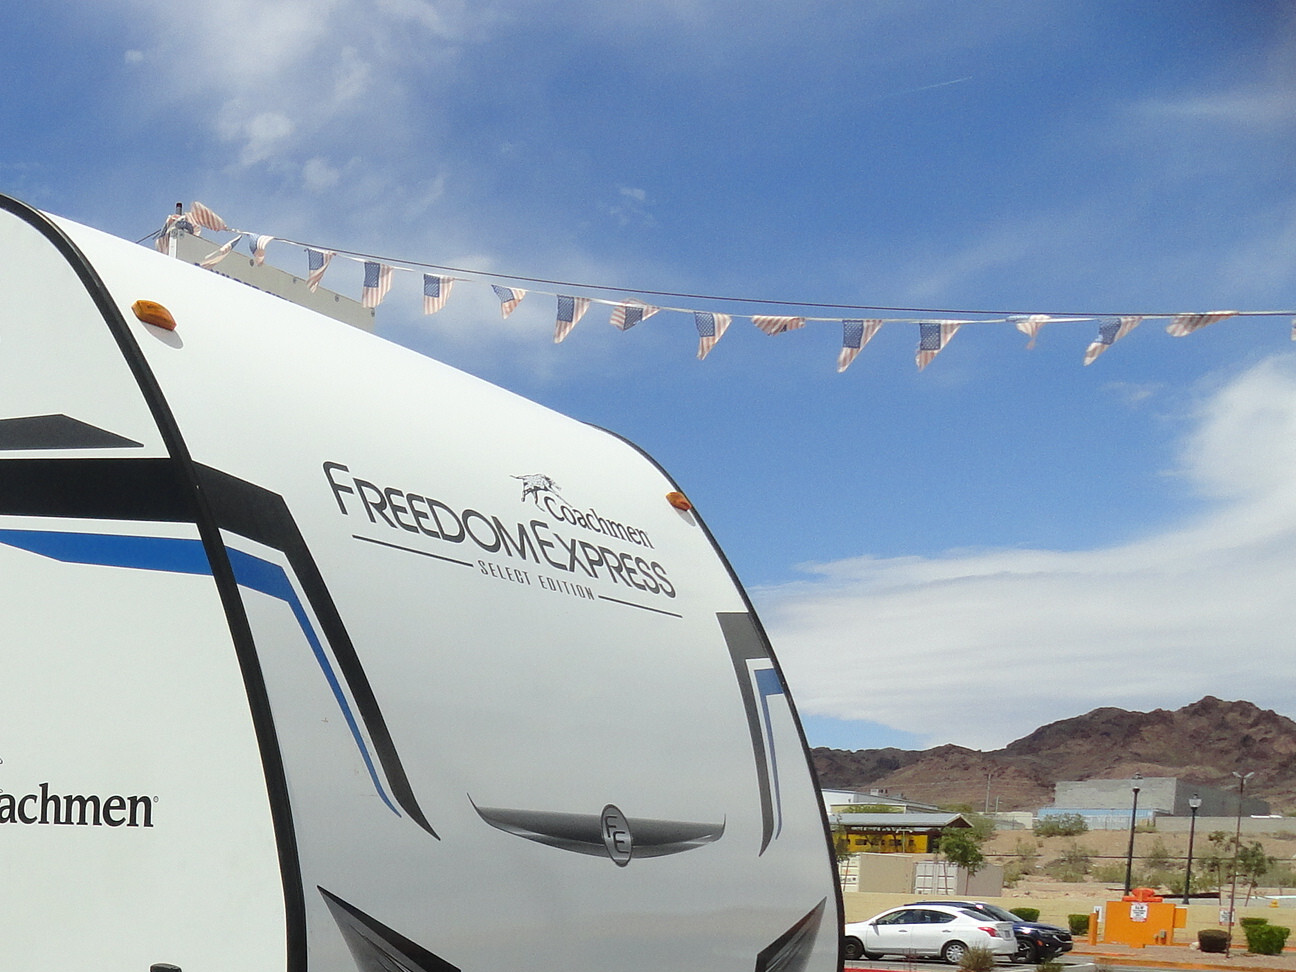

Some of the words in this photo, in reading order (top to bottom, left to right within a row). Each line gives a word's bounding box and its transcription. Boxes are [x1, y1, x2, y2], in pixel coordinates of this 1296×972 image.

[543, 495, 655, 550] Coachmen
[477, 558, 532, 586] SELECT
[538, 574, 595, 601] EDITION
